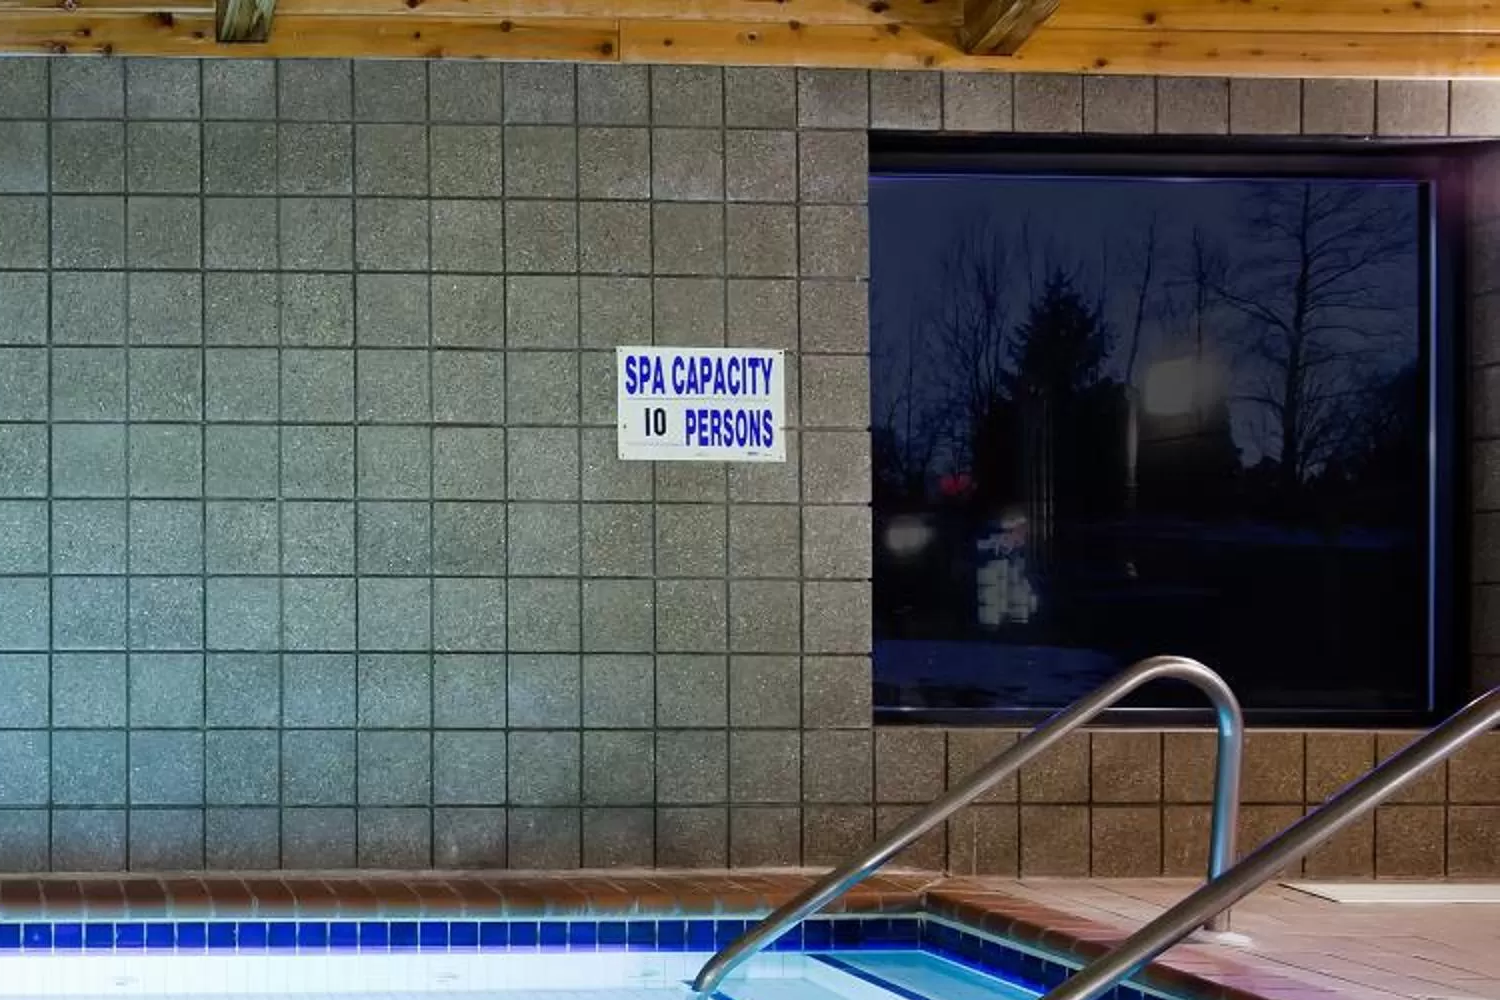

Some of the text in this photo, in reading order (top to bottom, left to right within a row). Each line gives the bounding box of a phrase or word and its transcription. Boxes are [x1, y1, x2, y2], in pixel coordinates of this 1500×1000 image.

[625, 355, 773, 396] SPA CAPACITY
[644, 407, 773, 448] 10 PERSONS
